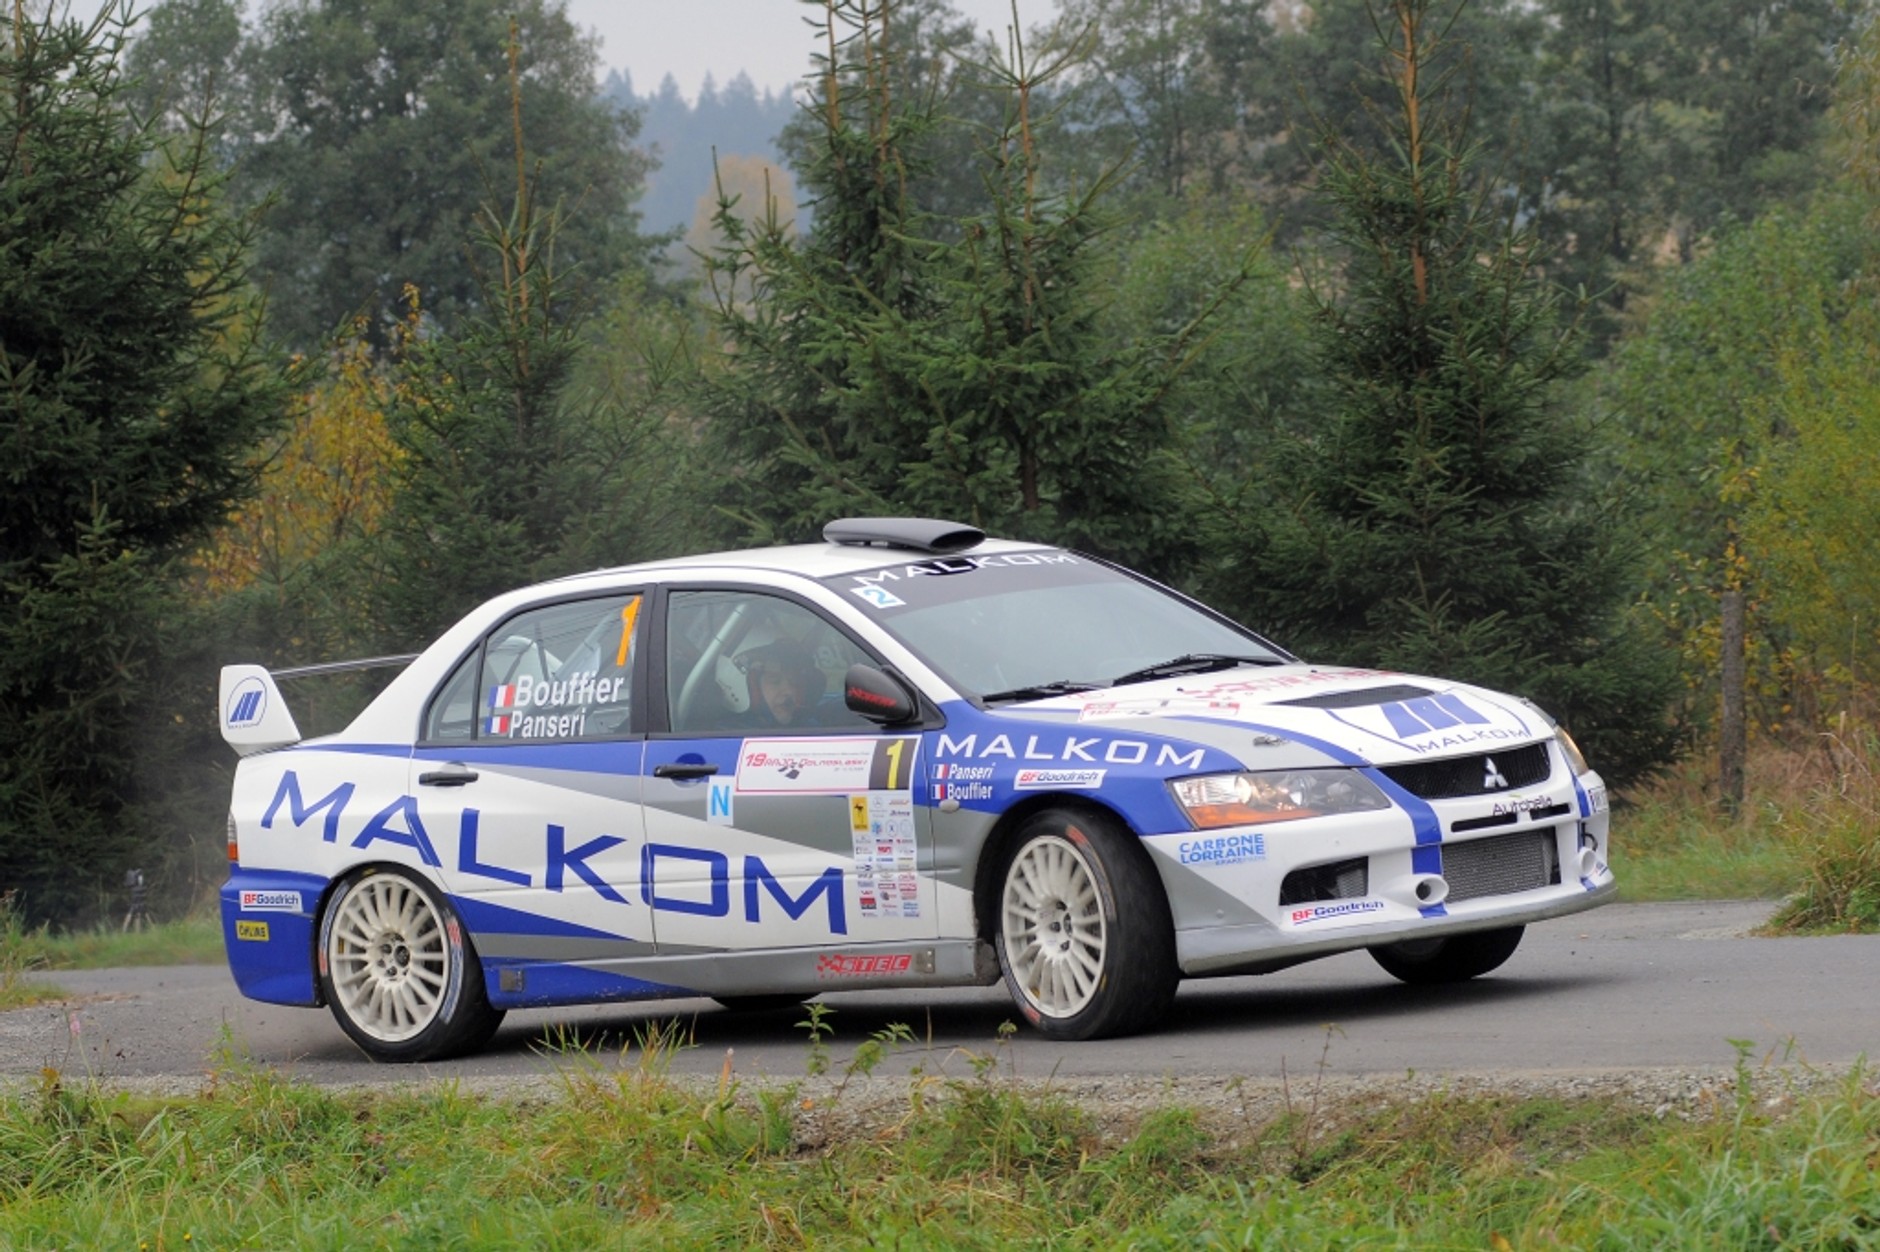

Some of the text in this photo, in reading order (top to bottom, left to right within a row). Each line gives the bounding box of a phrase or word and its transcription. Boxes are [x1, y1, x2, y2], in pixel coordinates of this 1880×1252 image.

[852, 553, 1079, 587] MALKOM
[862, 588, 896, 605] 2
[616, 595, 643, 667] 1
[514, 671, 625, 707] Bouffier
[508, 708, 586, 738] Panseri
[935, 734, 1206, 769] MALKOM
[1415, 728, 1530, 754] MALKOM
[745, 753, 767, 767] 19
[886, 739, 904, 790] 1
[948, 762, 997, 780] Panseri
[1018, 769, 1100, 784] BFGoodrich
[711, 785, 730, 816] N
[947, 783, 993, 800] Bouffier
[261, 770, 848, 935] MALKOM
[1179, 833, 1265, 854] CARBONE
[1180, 844, 1266, 864] LORRAINE
[244, 893, 299, 905] BFGoodrich
[1291, 900, 1385, 922] BFGoodrich
